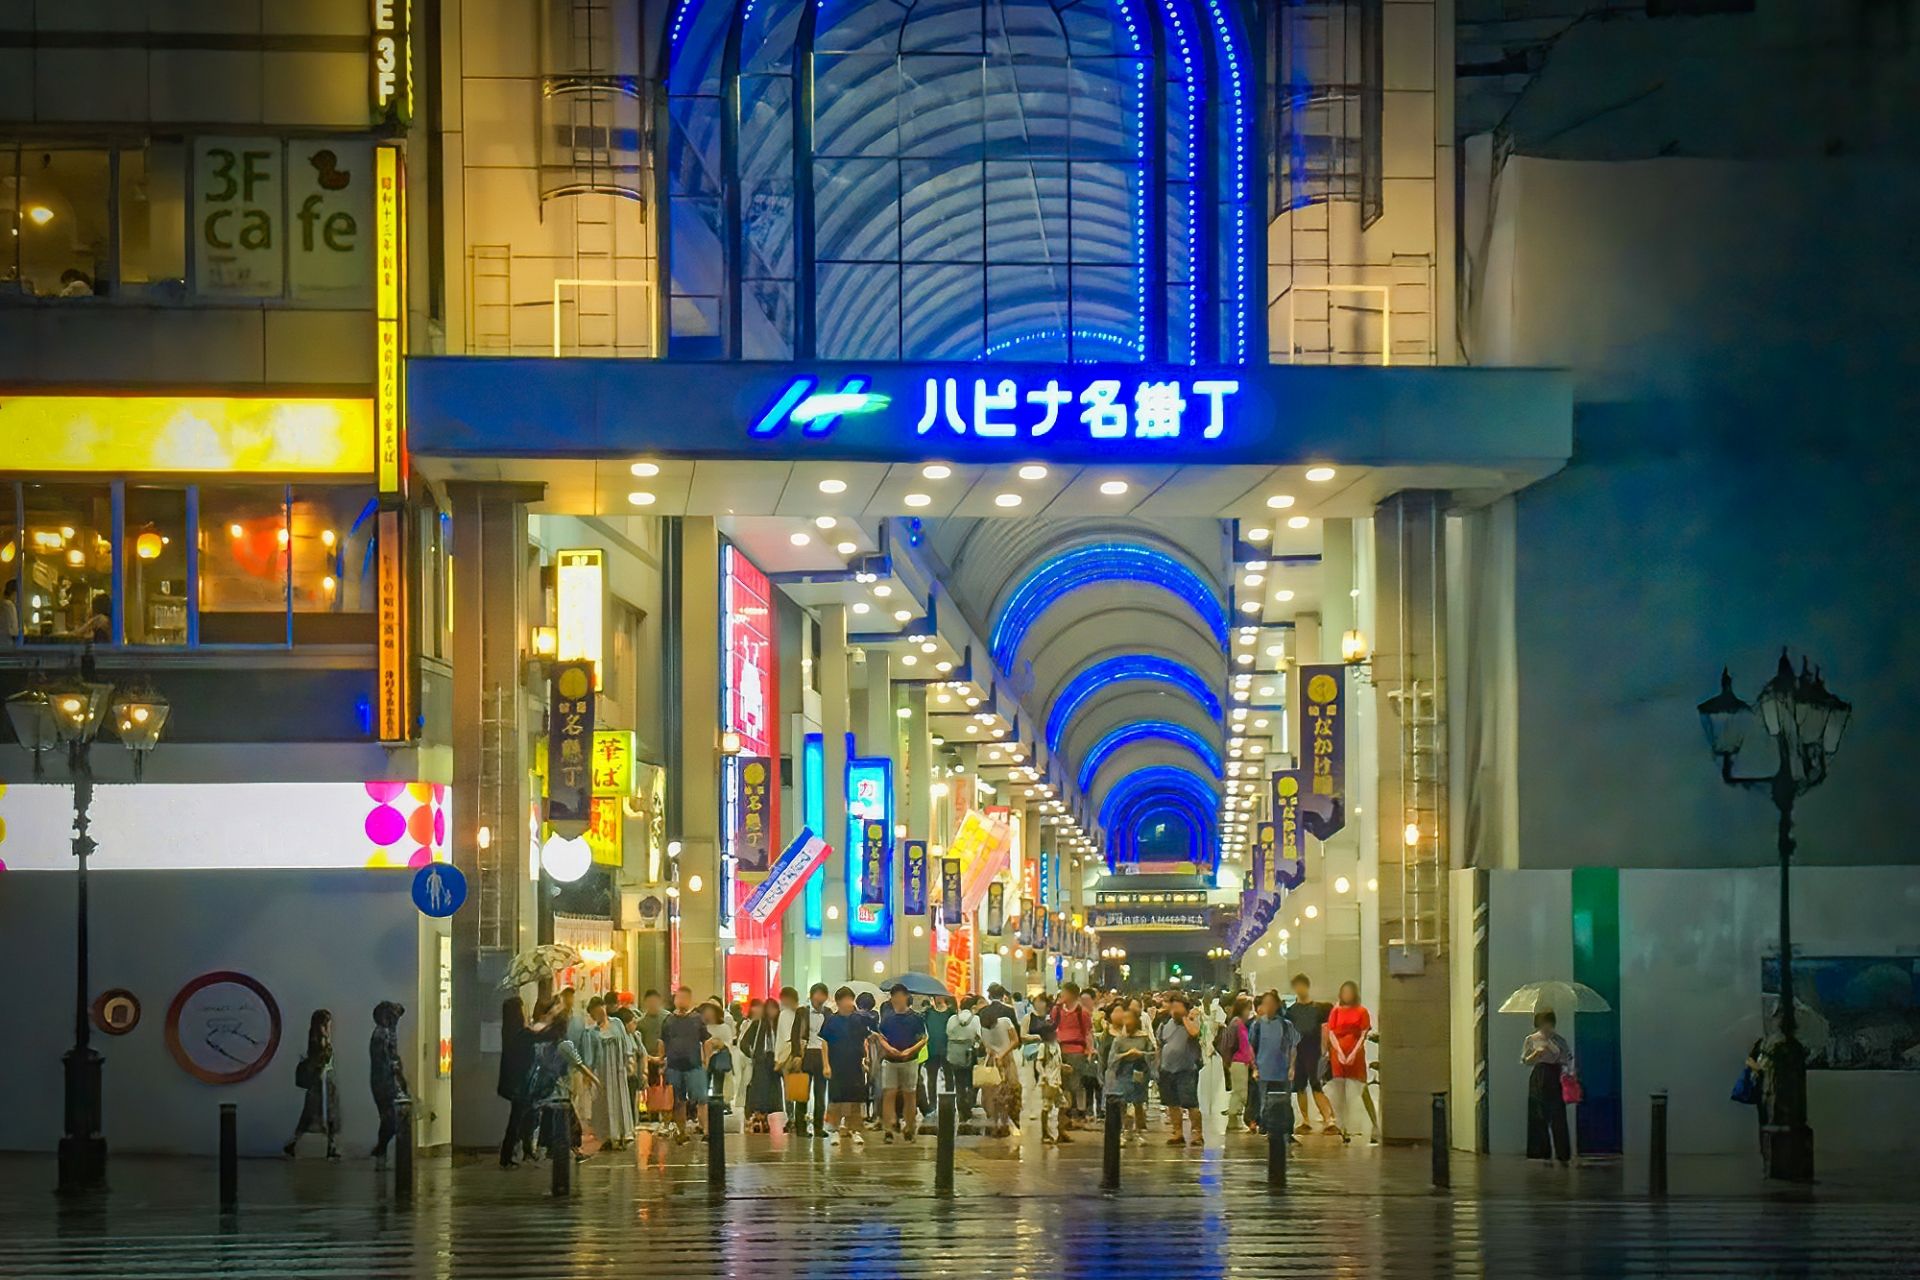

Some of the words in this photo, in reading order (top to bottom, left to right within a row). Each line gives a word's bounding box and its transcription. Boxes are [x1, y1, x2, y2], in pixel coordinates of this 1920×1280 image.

[205, 148, 272, 203] 3F
[917, 378, 1240, 438] ハピナ名掛丁
